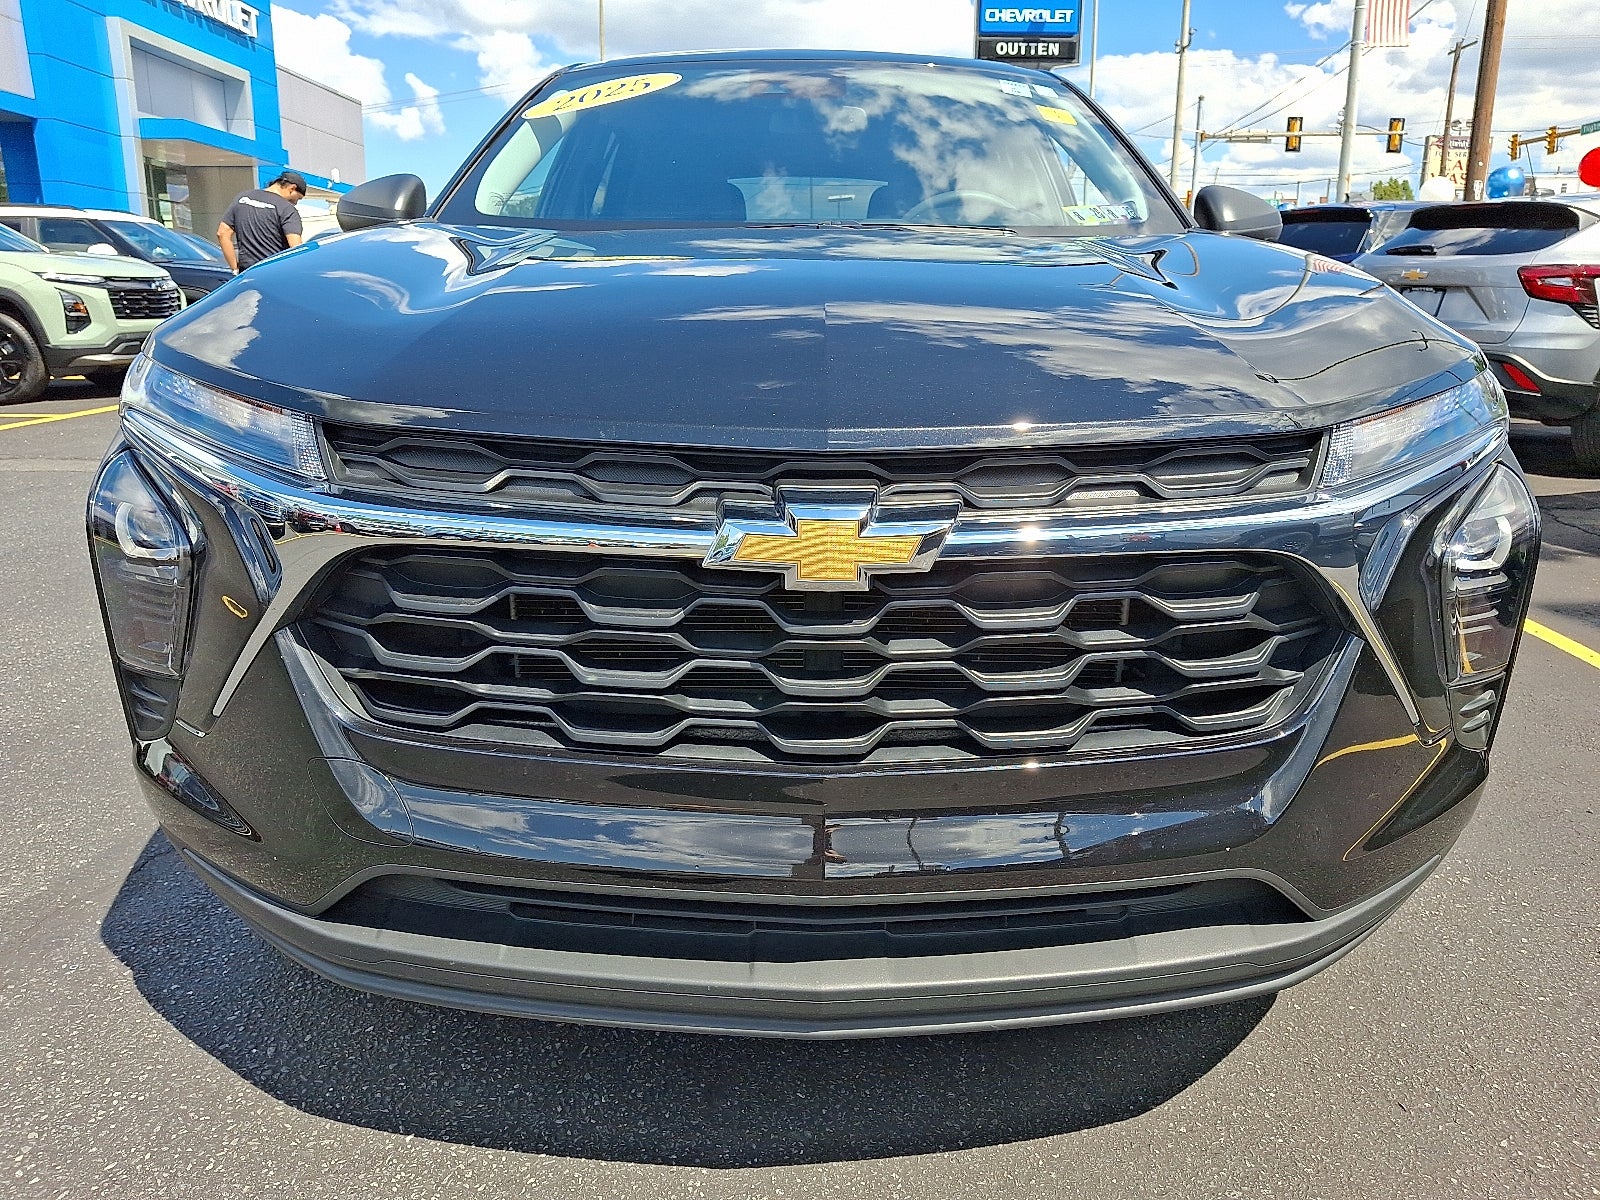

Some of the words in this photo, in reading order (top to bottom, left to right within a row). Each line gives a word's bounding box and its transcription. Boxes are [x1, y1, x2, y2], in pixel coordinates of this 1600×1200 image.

[985, 8, 1075, 22] CHEVROLET
[996, 42, 1059, 55] OUTTEN
[553, 77, 650, 112] 2025
